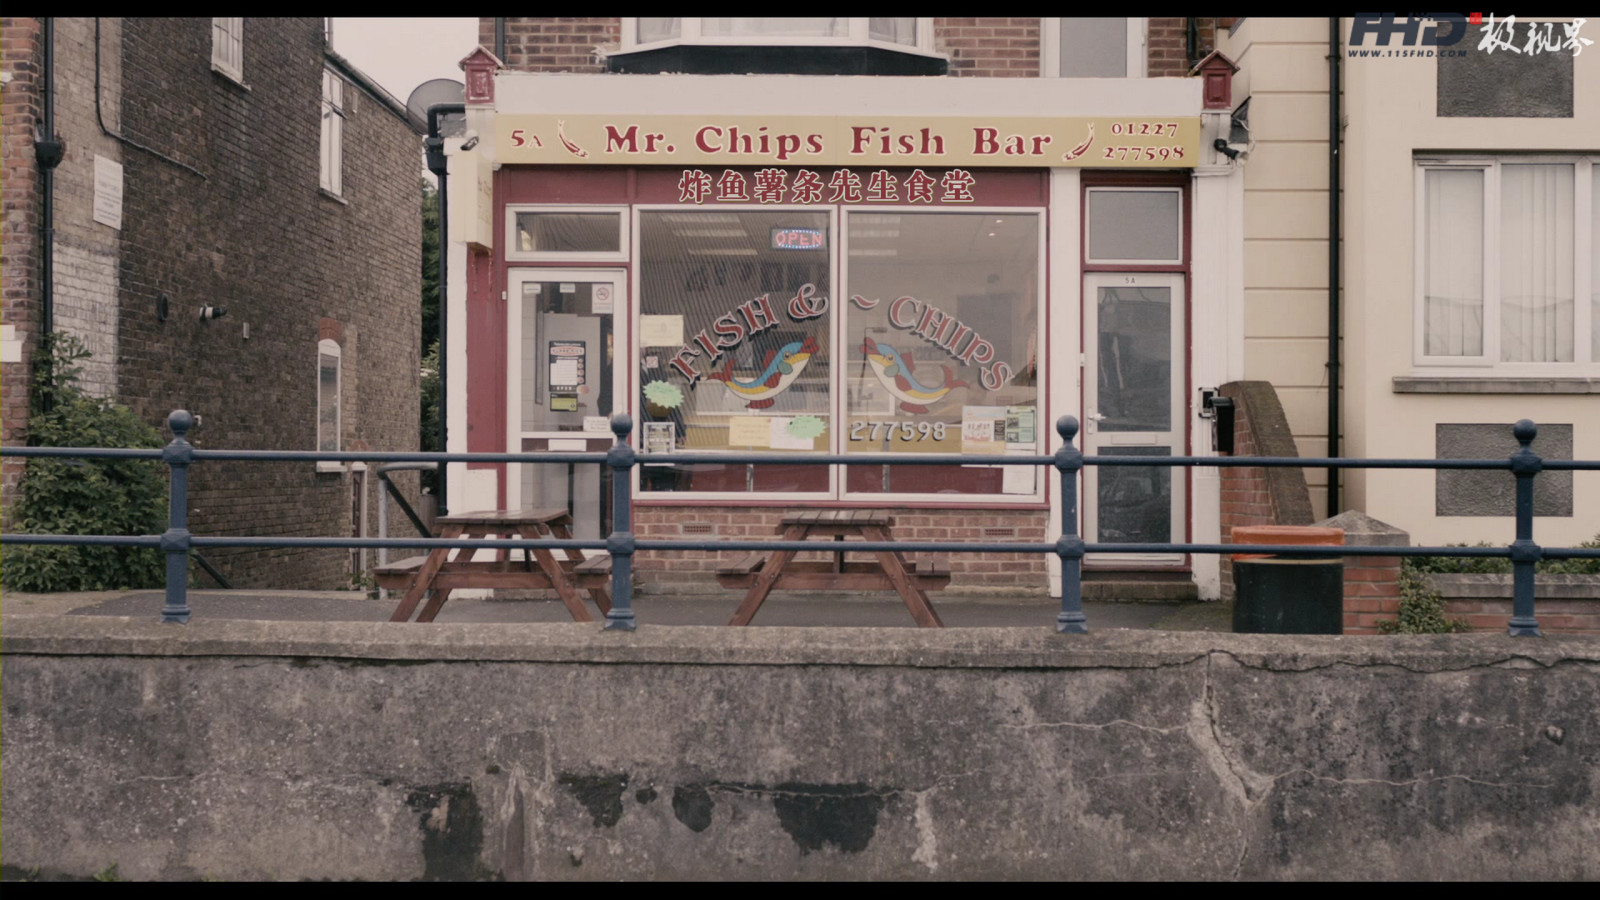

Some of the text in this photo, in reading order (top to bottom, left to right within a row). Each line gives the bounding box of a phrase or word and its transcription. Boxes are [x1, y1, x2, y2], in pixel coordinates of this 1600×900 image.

[604, 124, 1052, 160] Mr. Chips Fish Bar
[1102, 122, 1185, 162] 01227 277598
[775, 231, 823, 247] OPEN
[669, 283, 1015, 392] FISH & CHIPS
[850, 420, 946, 442] 277598
